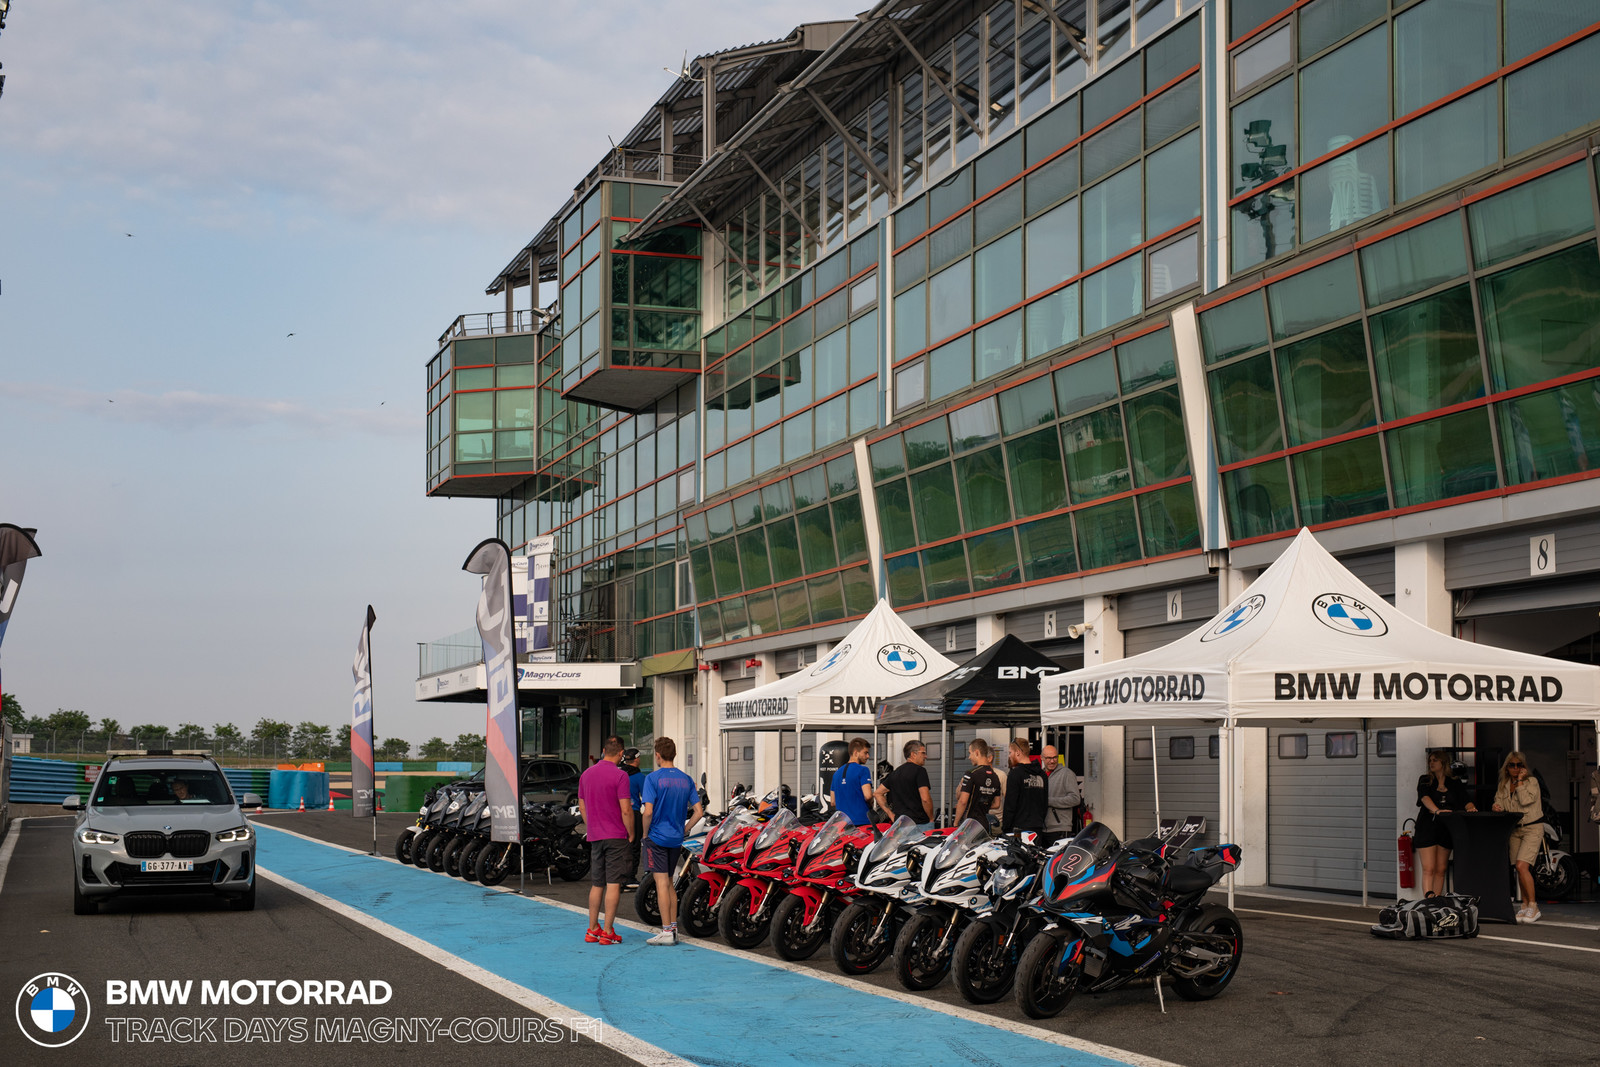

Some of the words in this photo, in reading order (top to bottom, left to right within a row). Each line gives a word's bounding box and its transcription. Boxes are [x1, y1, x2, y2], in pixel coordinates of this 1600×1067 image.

[1536, 538, 1549, 570] 8
[1170, 592, 1178, 617] 6
[1317, 595, 1365, 610] BMW
[1047, 613, 1053, 635] 5
[881, 645, 916, 656] BMW
[525, 671, 582, 679] Magny-Cours
[1058, 681, 1100, 708] BMW
[1103, 674, 1205, 704] MOTORRAD
[1274, 672, 1361, 701] BMW
[1373, 672, 1563, 702] MOTORRAD
[725, 701, 744, 719] BMW
[745, 697, 788, 717] MOTORRAD
[1061, 854, 1082, 872] 2
